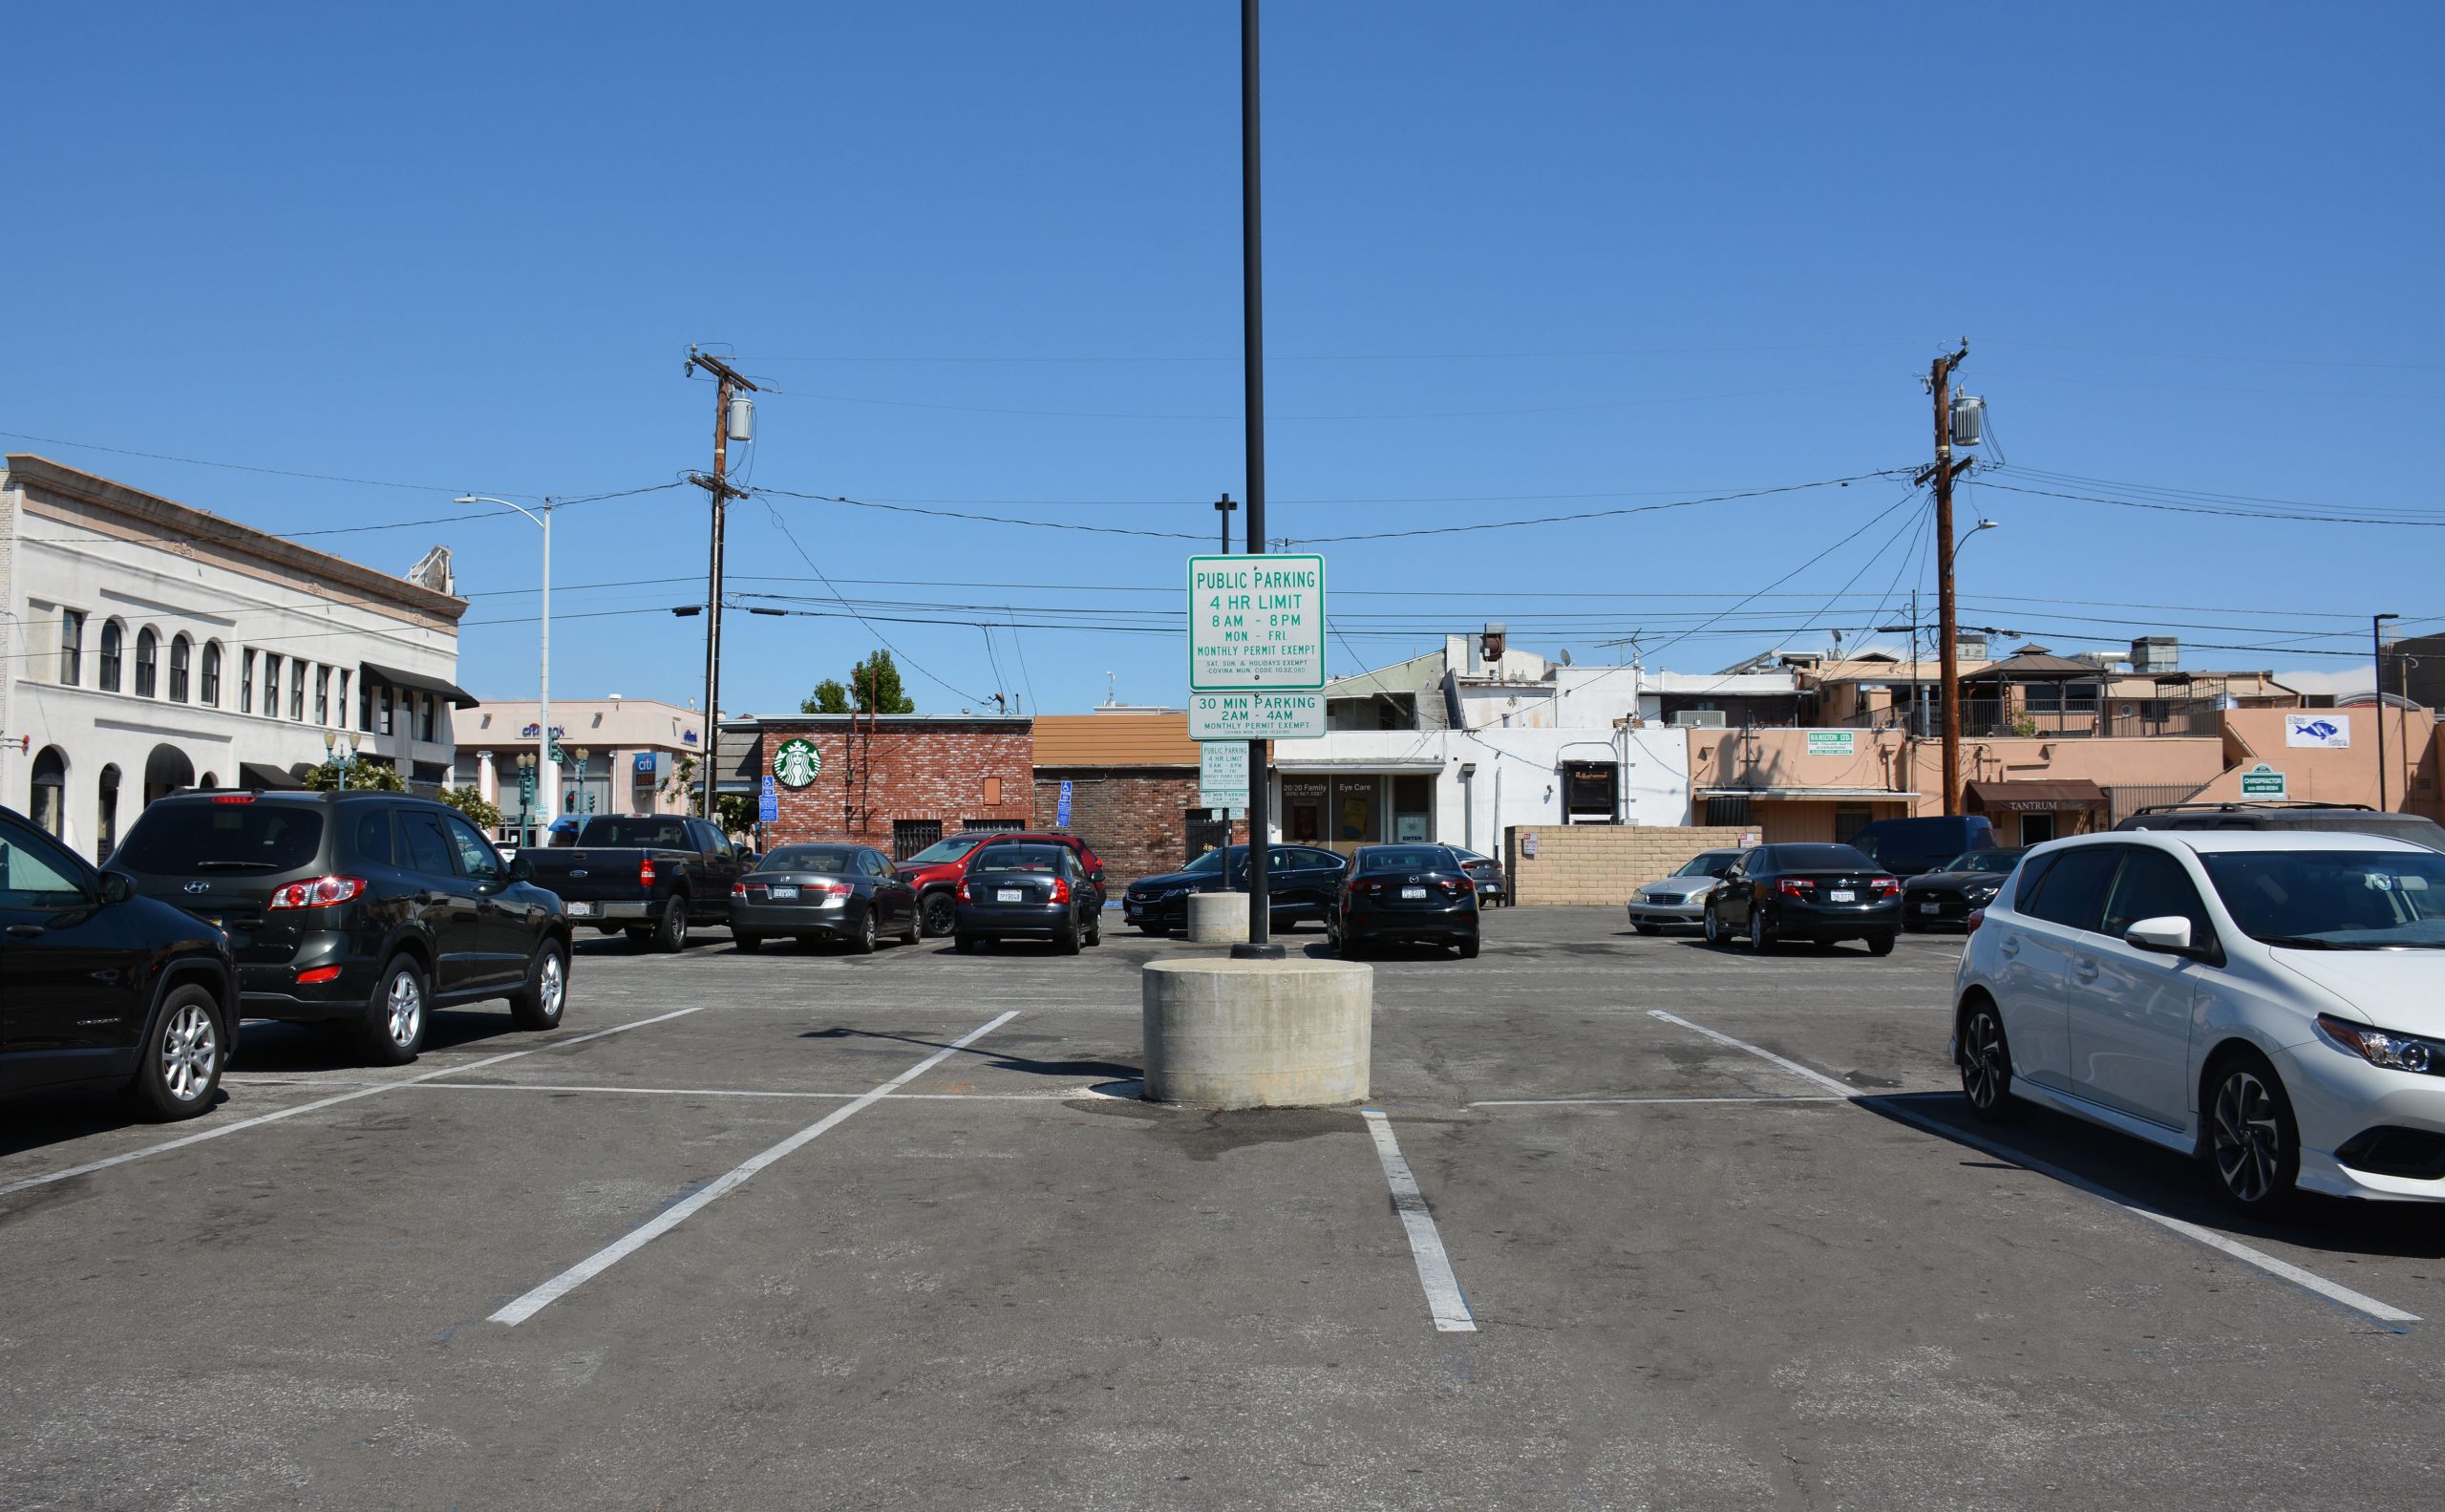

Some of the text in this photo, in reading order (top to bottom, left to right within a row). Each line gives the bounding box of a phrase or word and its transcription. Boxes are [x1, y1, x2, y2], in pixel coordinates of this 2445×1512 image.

[1197, 571, 1315, 589] PUBLIC PARKING
[1210, 596, 1220, 609] 4
[1259, 595, 1302, 609] LIMIT
[1197, 645, 1315, 656] MONTHLY PERMIT EXEMPT
[1199, 697, 1315, 709] 30 MIN PARKING
[1304, 784, 1327, 792] Family
